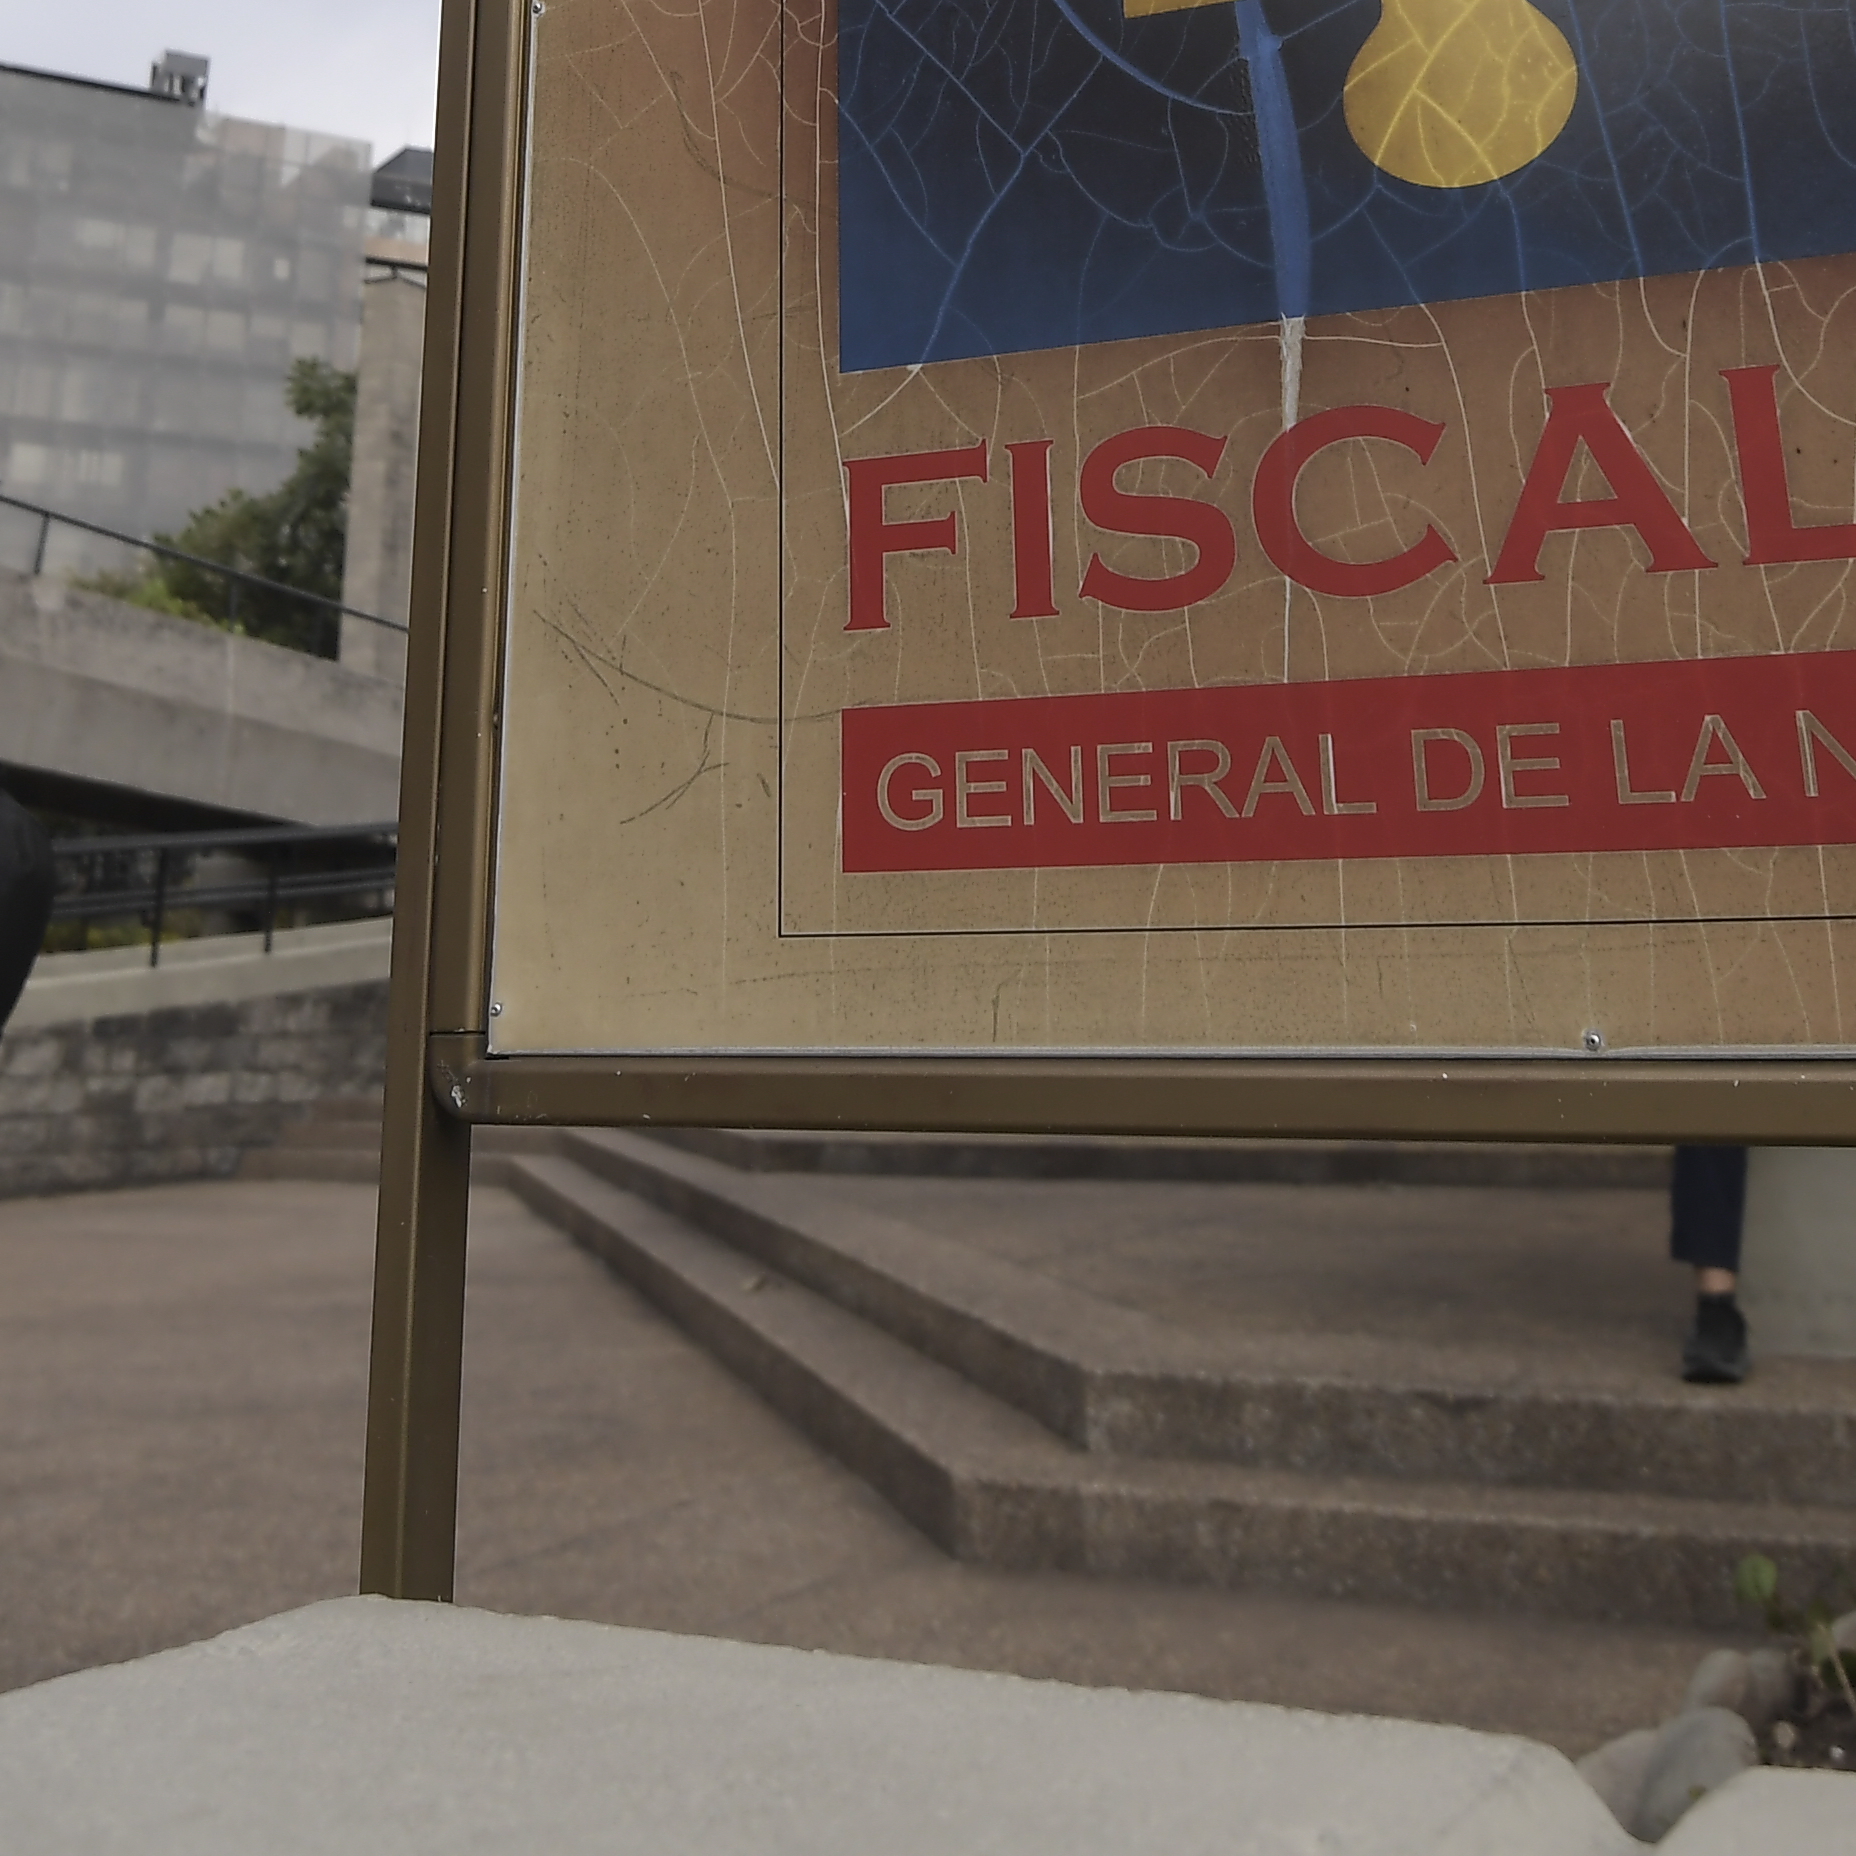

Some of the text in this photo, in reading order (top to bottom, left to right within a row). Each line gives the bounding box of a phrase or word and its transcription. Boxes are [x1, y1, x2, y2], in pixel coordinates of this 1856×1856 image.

[876, 734, 1376, 832] GENERAL
[1411, 722, 1570, 812] DE
[1610, 714, 1766, 804] LA
